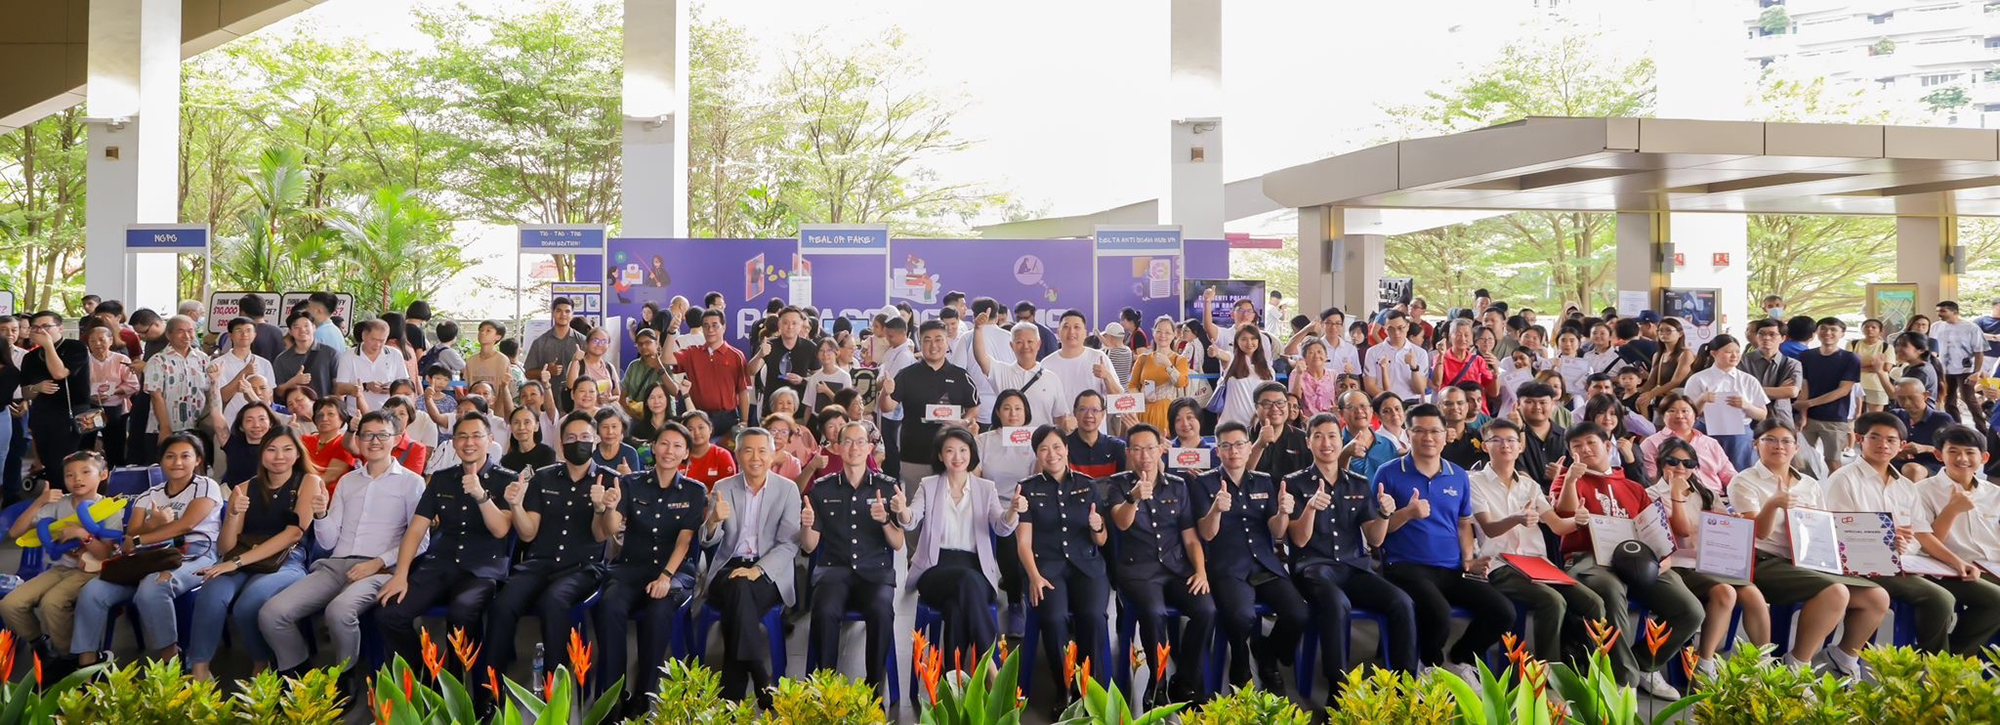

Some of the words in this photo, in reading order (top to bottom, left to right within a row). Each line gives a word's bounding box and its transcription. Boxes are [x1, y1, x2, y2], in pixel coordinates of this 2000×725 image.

[808, 235, 832, 244] REAL
[833, 235, 845, 244] OR
[213, 306, 238, 315] $10,000
